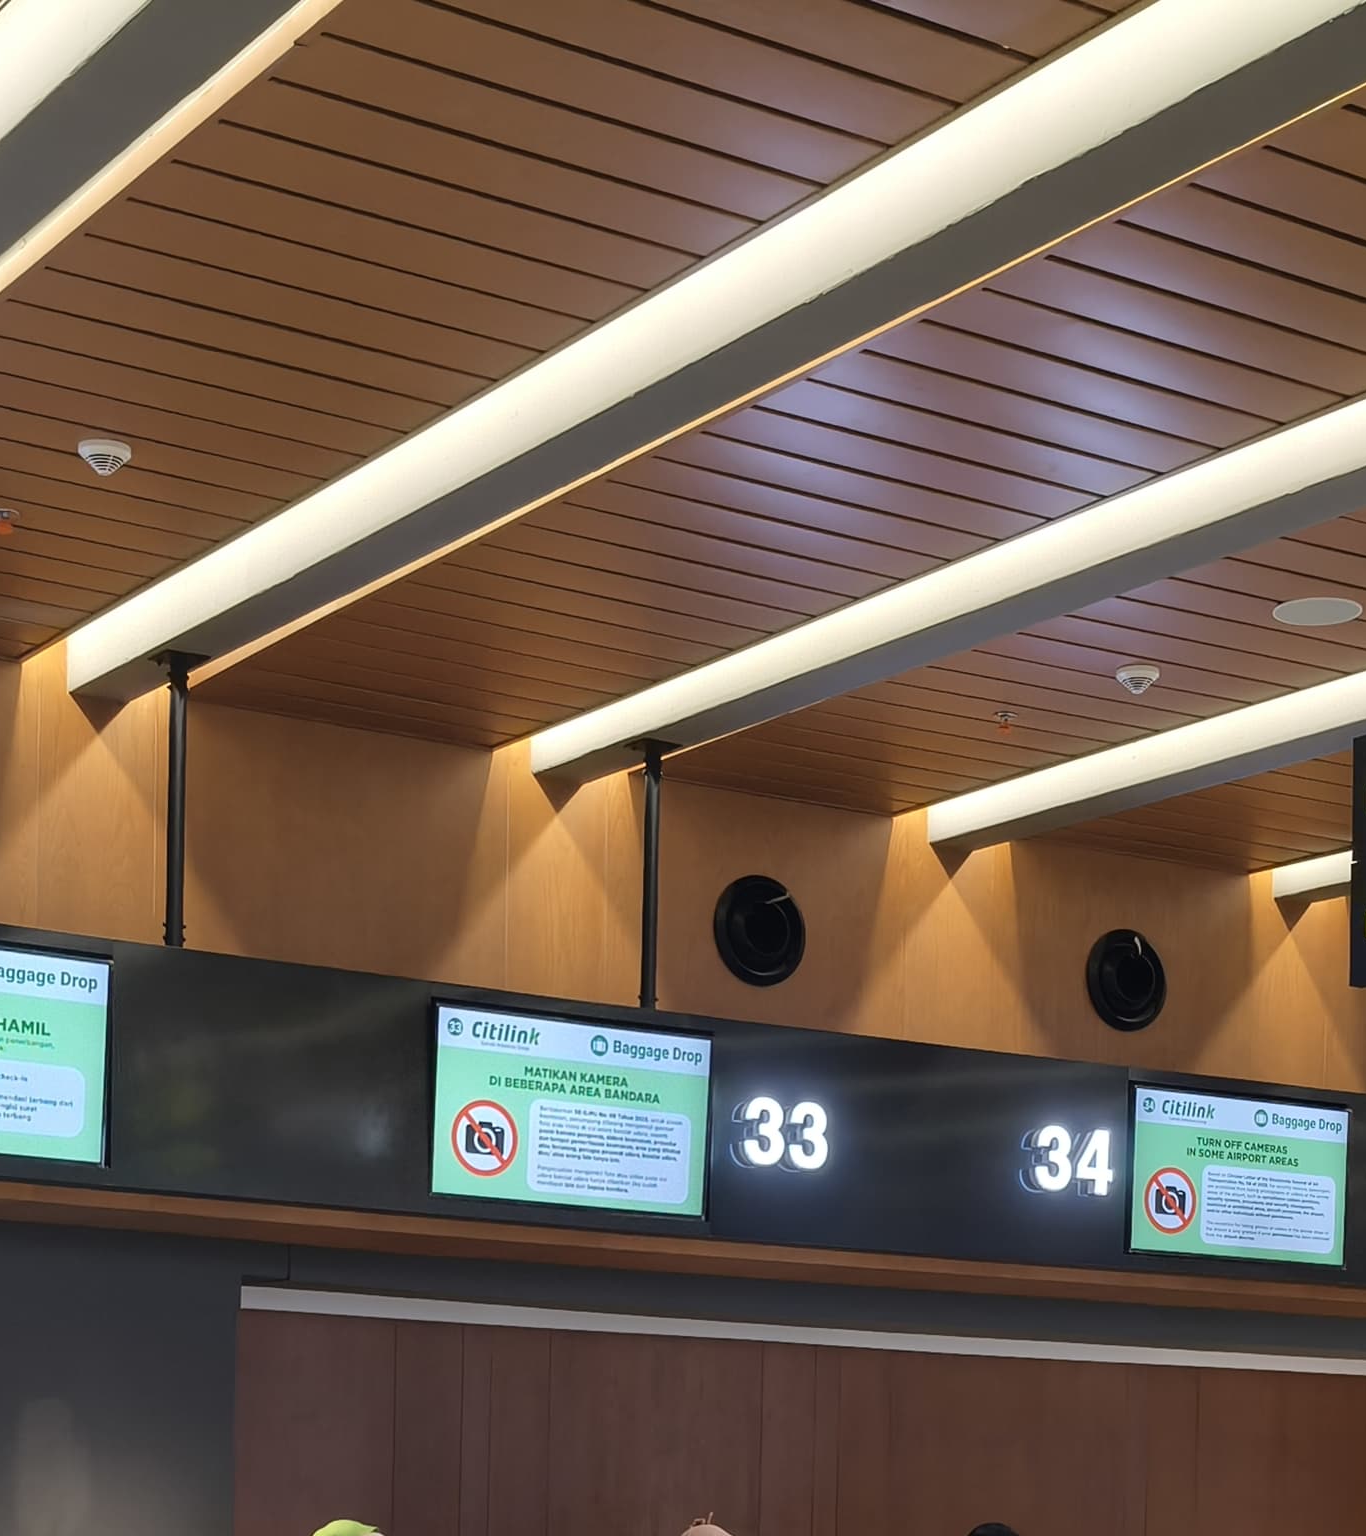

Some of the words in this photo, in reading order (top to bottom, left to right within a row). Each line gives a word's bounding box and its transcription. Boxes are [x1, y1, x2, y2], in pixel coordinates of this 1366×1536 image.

[60, 968, 99, 993] Drop
[471, 1021, 541, 1046] Citilink
[613, 1040, 669, 1061] Baggage
[673, 1047, 703, 1066] Drop
[524, 1066, 577, 1083] MATIKAN
[580, 1073, 628, 1088] KAMERA
[489, 1076, 501, 1087] DI
[505, 1077, 566, 1095] BEBERAPA
[569, 1085, 601, 1098] AREA
[605, 1089, 660, 1104] BANDARA
[1162, 1099, 1216, 1120] Citilink
[741, 1096, 829, 1171] 33
[1272, 1113, 1316, 1131] Baggage
[1318, 1118, 1342, 1134] Drop
[1186, 1147, 1196, 1157] IN
[1197, 1148, 1224, 1160] SOME
[1226, 1151, 1267, 1164] AIRPORT
[1268, 1156, 1299, 1167] AREAS
[1196, 1136, 1221, 1148] TURN
[1223, 1139, 1242, 1150] OFF
[1244, 1141, 1288, 1155] CAMERAS
[1033, 1124, 1113, 1196] 34
